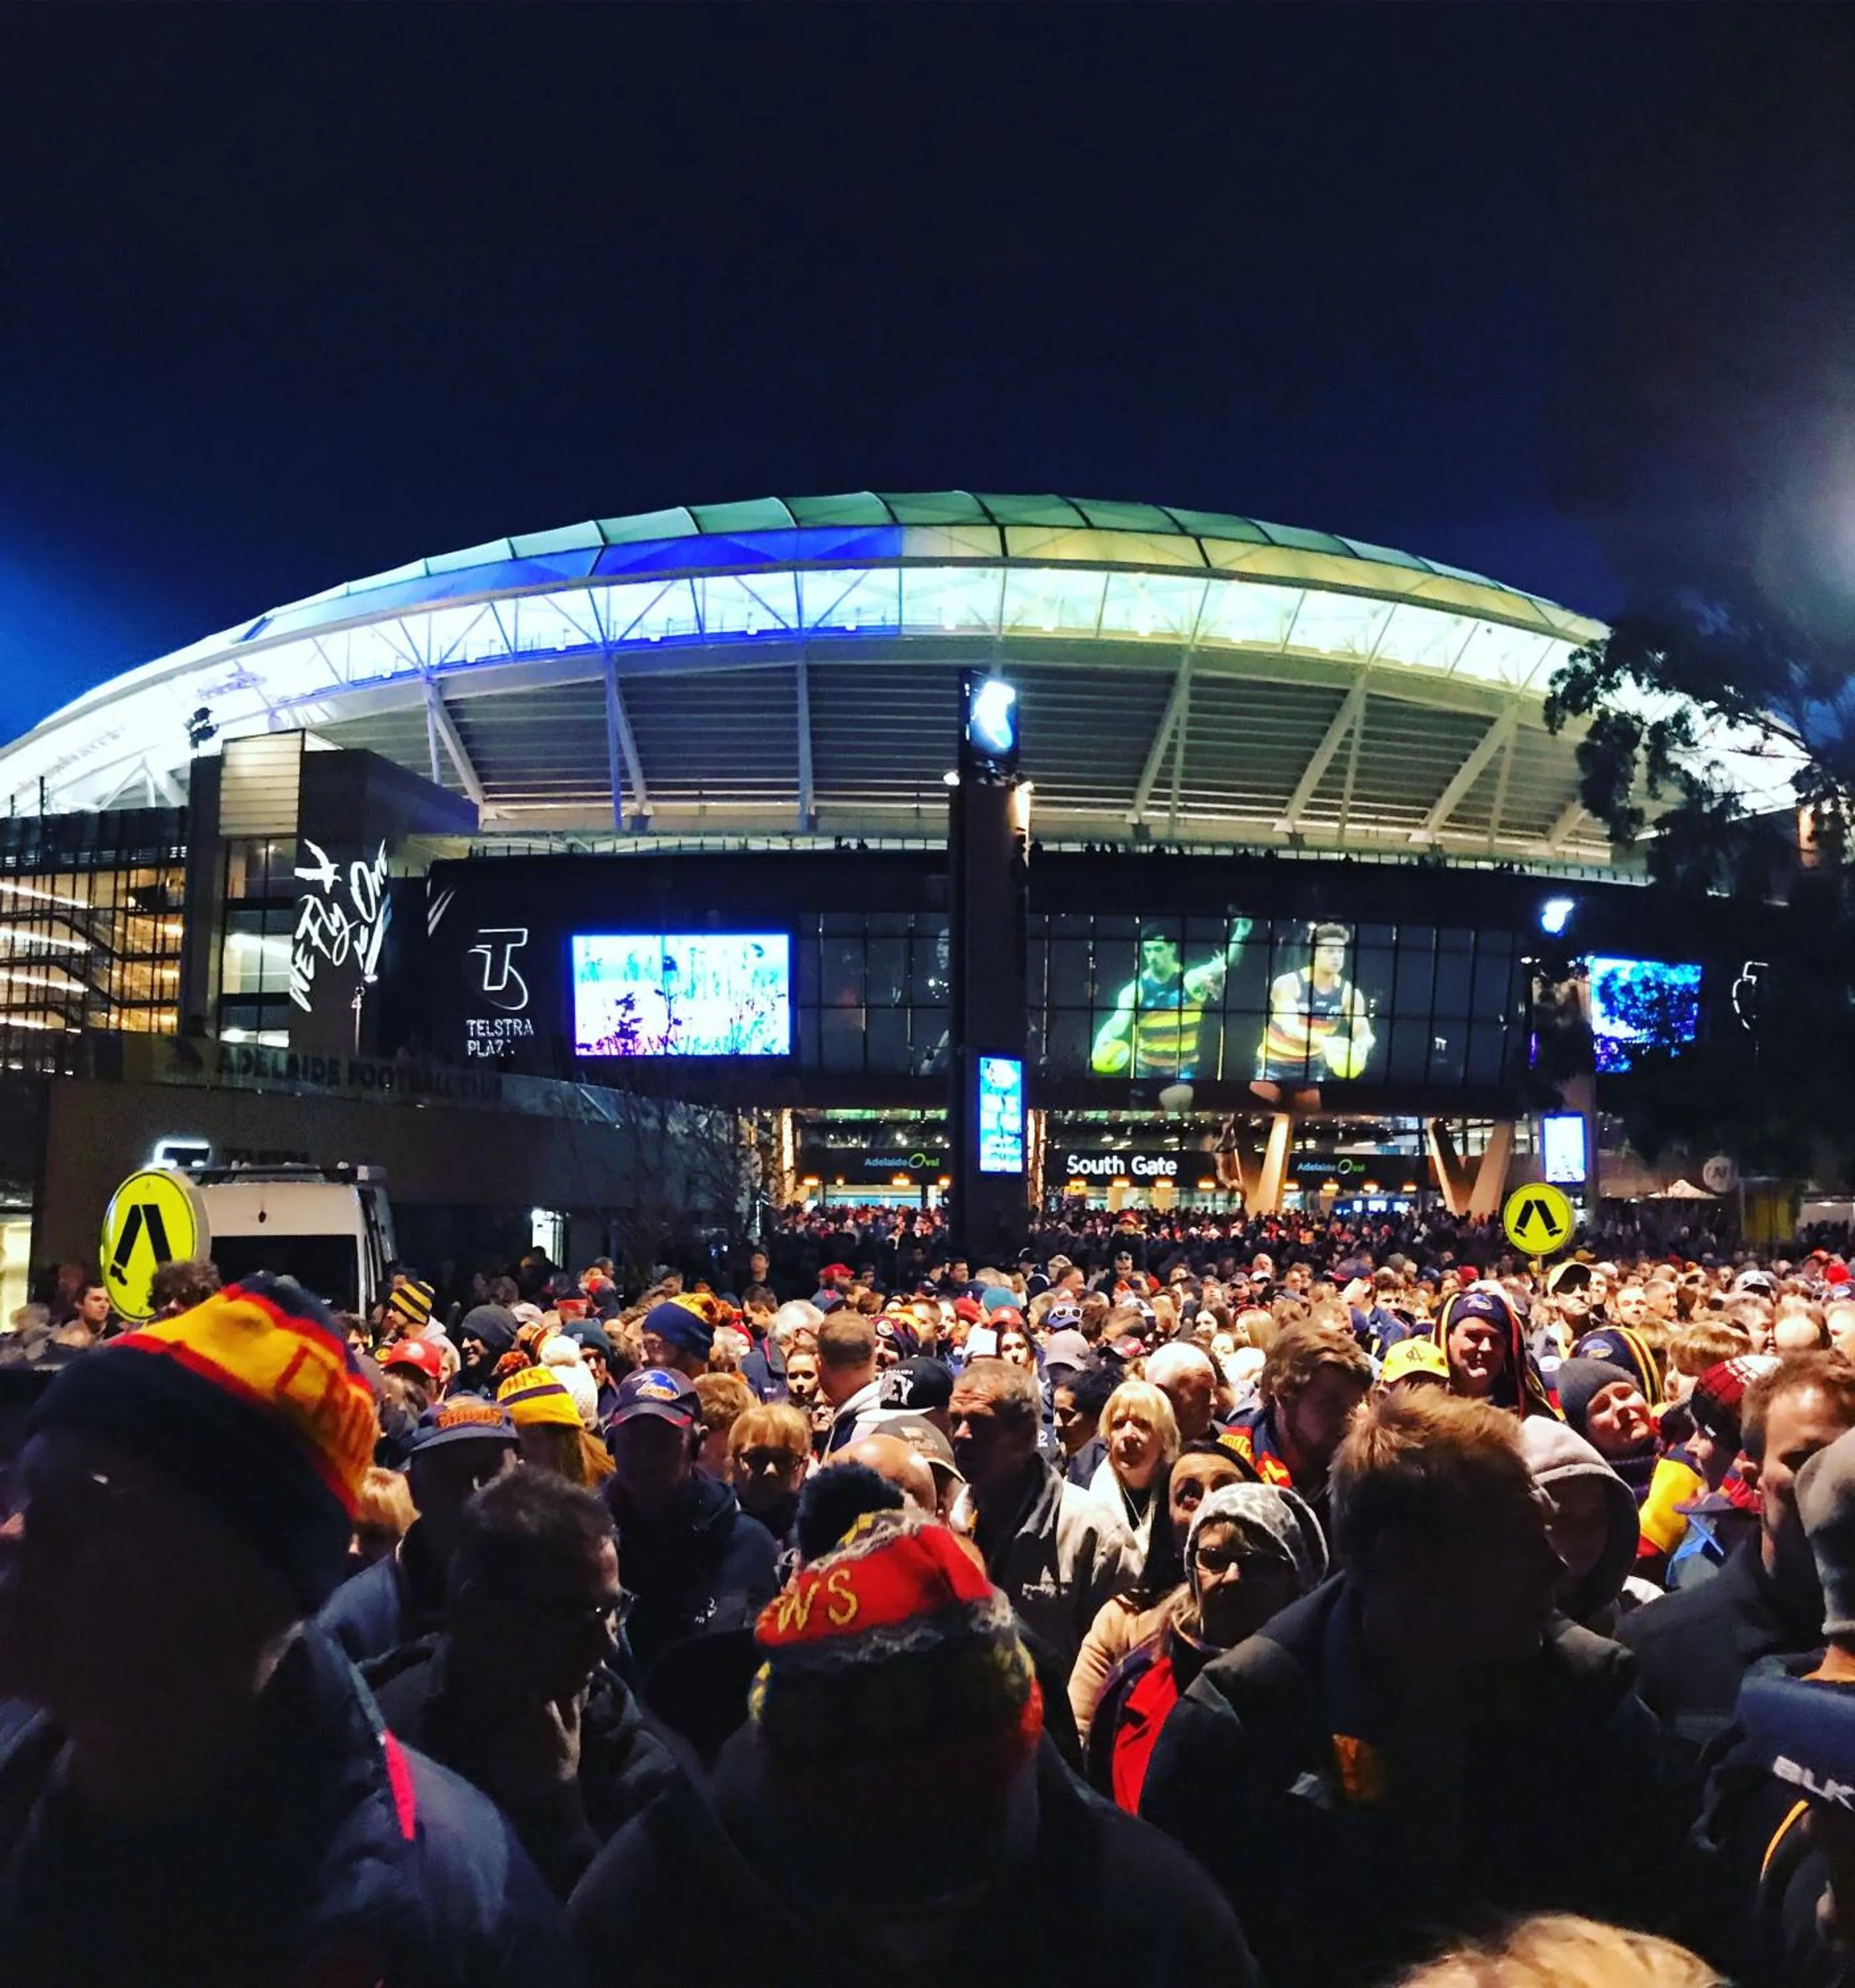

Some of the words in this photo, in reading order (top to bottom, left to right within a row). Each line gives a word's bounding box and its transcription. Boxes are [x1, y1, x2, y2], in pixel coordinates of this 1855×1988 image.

[295, 894, 361, 967] Fly
[466, 1019, 535, 1037] TELSTRA
[466, 1039, 515, 1058] PLAZ
[864, 1157, 908, 1167] Adelaide
[908, 1153, 940, 1168] Oval
[1067, 1154, 1126, 1175] South
[1131, 1155, 1178, 1176] Gate
